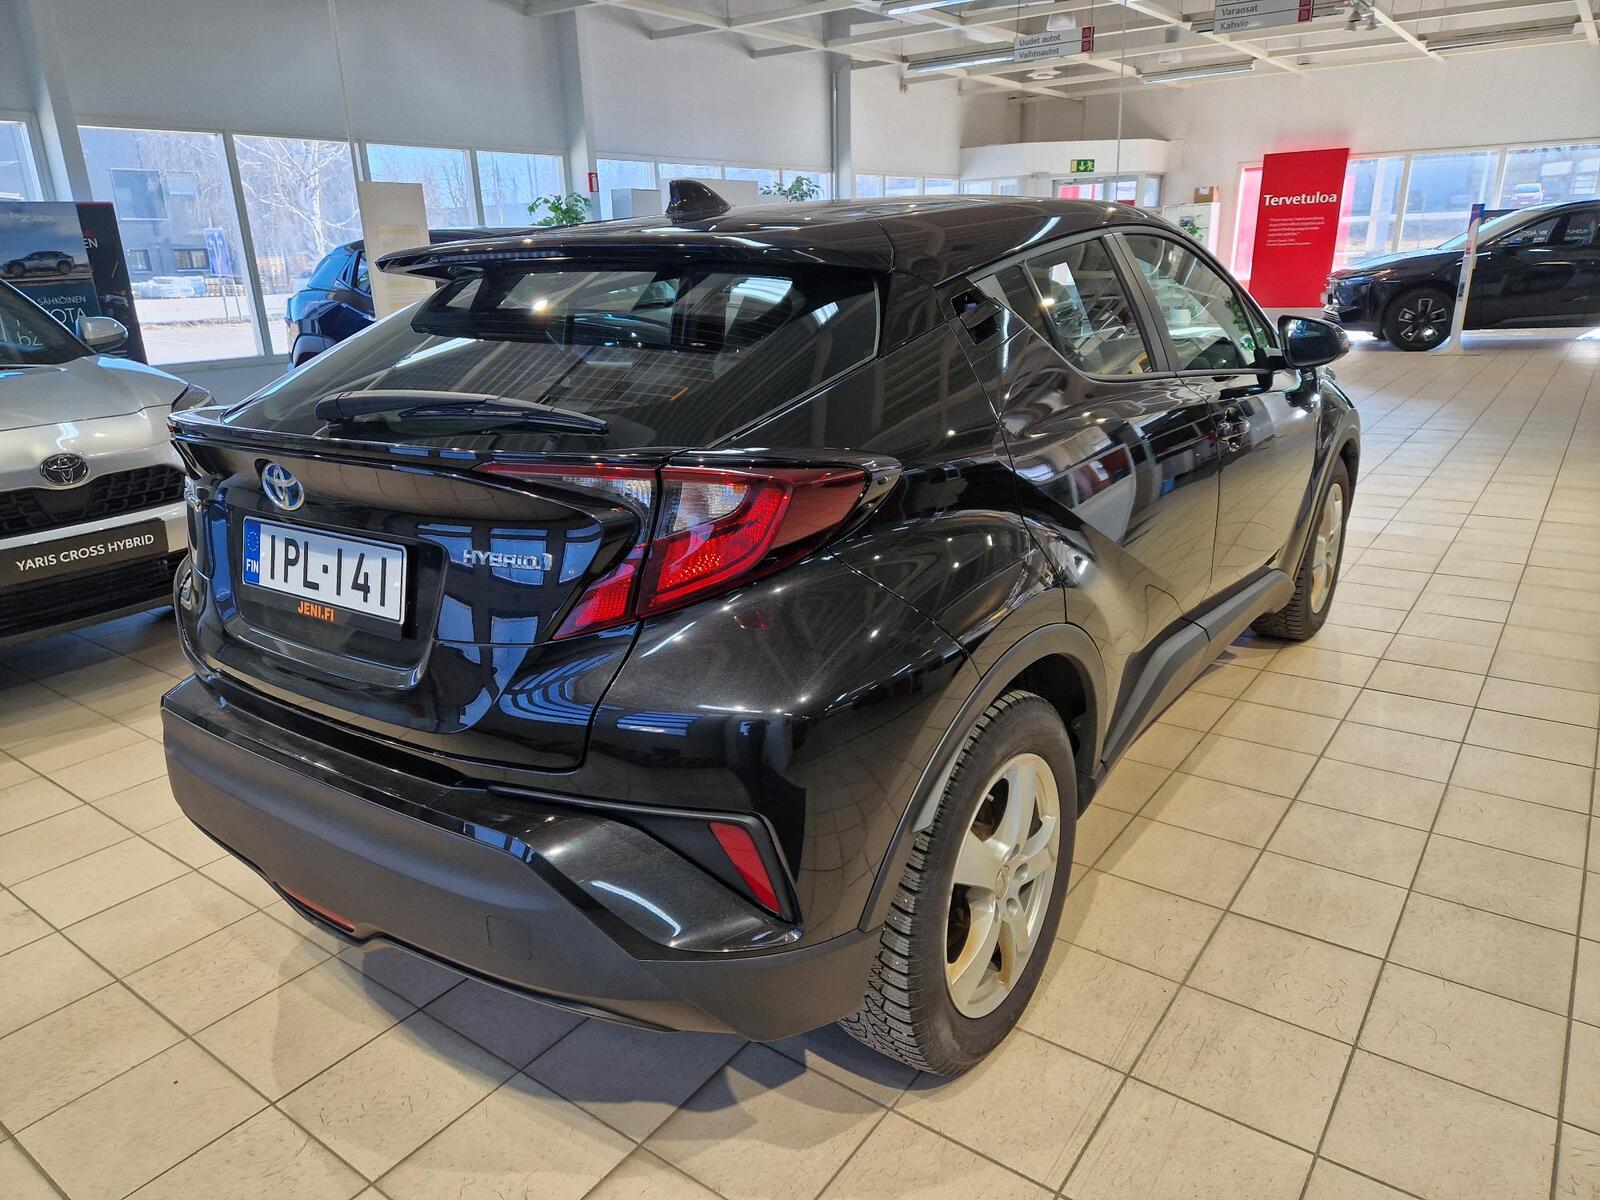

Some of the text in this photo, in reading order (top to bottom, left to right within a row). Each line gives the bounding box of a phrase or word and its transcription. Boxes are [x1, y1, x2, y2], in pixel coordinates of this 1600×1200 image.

[1221, 4, 1258, 17] Varaosat
[1220, 20, 1249, 31] Kahvio
[1019, 34, 1061, 47] Uudet autot
[1018, 47, 1060, 58] Vaihtoautot
[1263, 191, 1338, 206] Tervetuloa
[83, 238, 99, 249] EN
[46, 307, 87, 324] OTA
[16, 534, 155, 572] YARIS CROSS HYBRID
[463, 548, 542, 570] HYBRID
[246, 559, 259, 574] FIN
[270, 534, 388, 608] IPL-141
[297, 601, 335, 622] JENI.FI
